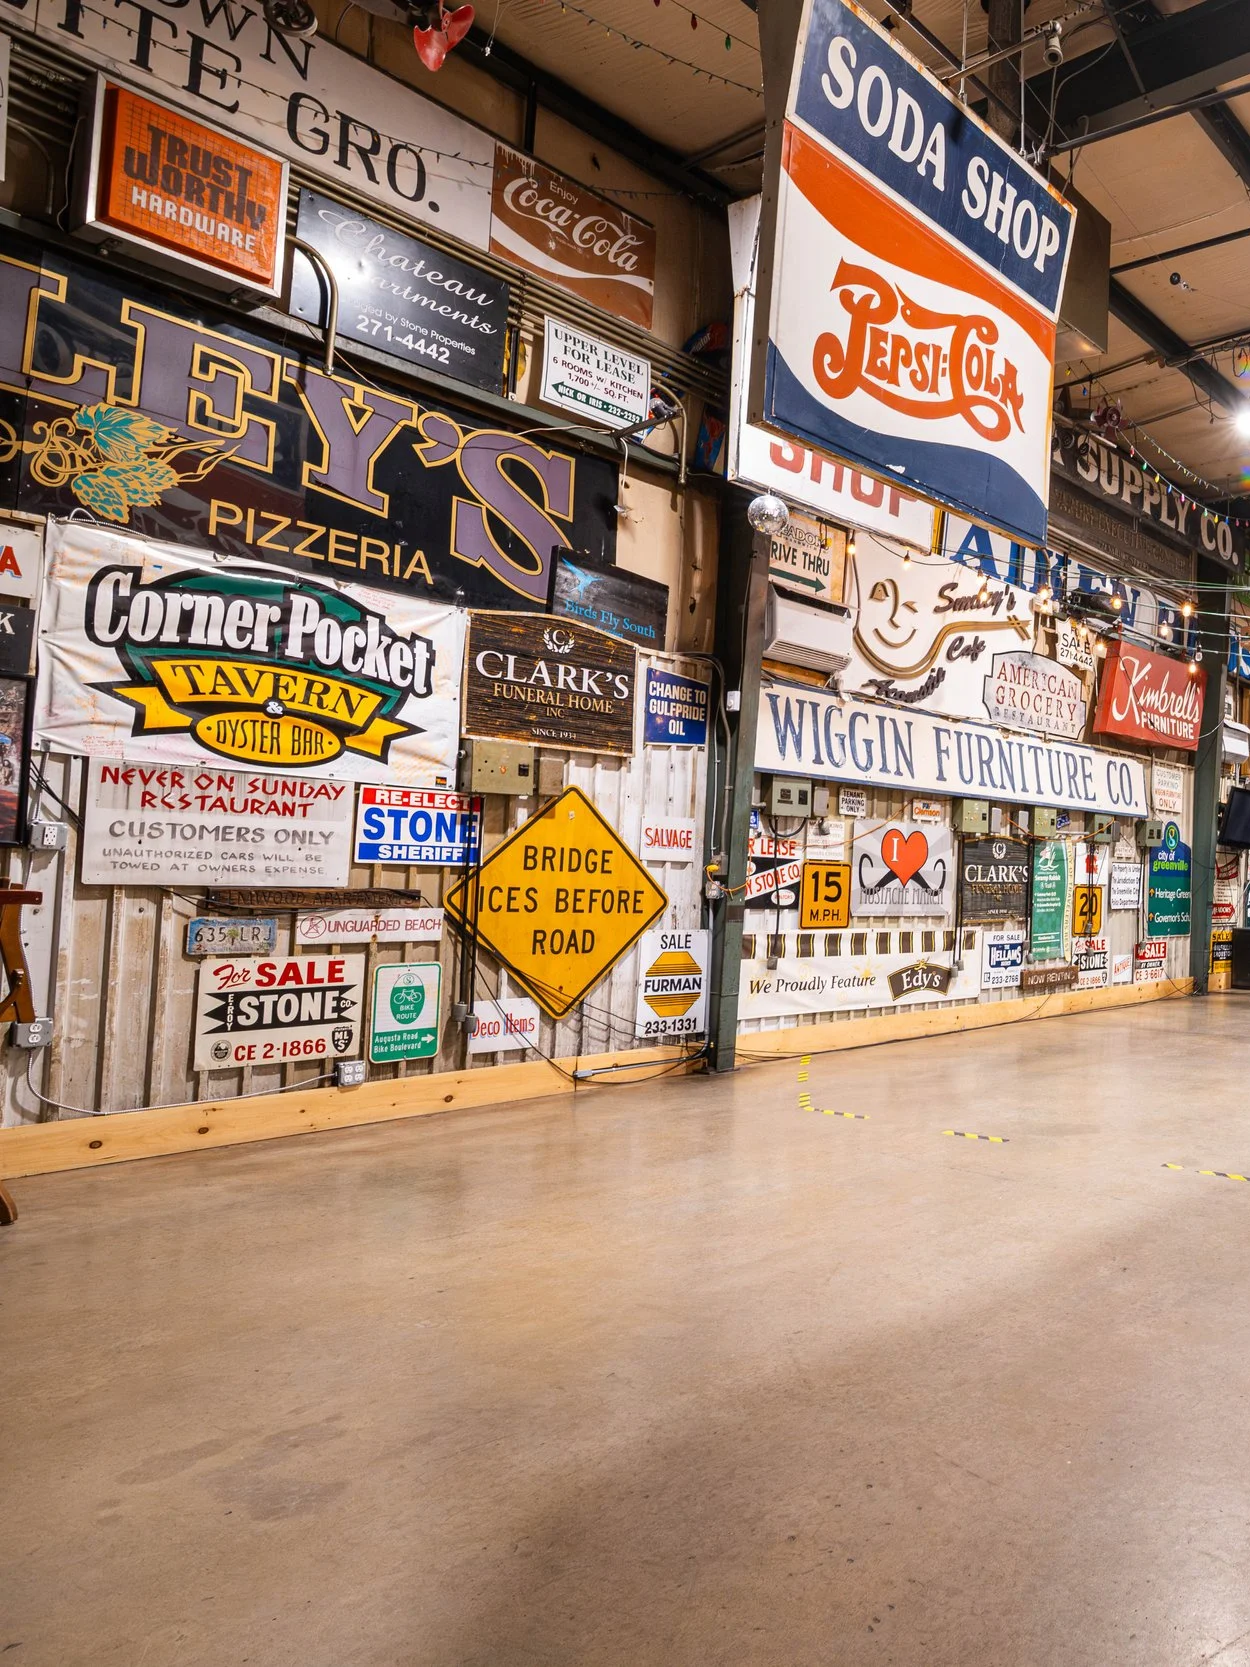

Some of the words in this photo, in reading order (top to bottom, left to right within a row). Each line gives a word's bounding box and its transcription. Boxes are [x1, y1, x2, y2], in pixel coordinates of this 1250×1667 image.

[821, 36, 947, 192] SODA
[147, 124, 252, 196] TRUST
[287, 91, 440, 213] GRO.
[124, 145, 267, 231] WORTHY
[550, 180, 579, 205] Enjoy
[131, 186, 256, 254] HARDWARE
[503, 177, 645, 273] Coca-Cola
[961, 155, 1060, 273] SHOP
[318, 209, 494, 307] Chateau
[356, 314, 451, 365] 271-4442
[385, 311, 399, 324] by
[400, 317, 429, 336] Stone
[430, 330, 476, 356] Properties
[554, 328, 598, 357] UPPER
[603, 346, 645, 377] LEVEL
[563, 345, 591, 366] FOR
[595, 357, 636, 385] LEASE
[552, 355, 559, 365] 6
[561, 359, 593, 382] ROOMS
[609, 379, 645, 401] KITCHEN
[567, 371, 590, 388] 1,700
[558, 384, 575, 400] NICK
[576, 390, 587, 402] OR
[589, 394, 603, 408] IRIS
[1077, 433, 1191, 535] SUPPLY
[1200, 512, 1239, 566] CO.
[208, 498, 435, 586] PIZZERIA
[802, 550, 830, 577] THRU
[565, 599, 598, 620] Birds
[600, 610, 620, 630] Fly
[622, 617, 657, 639] South
[92, 570, 282, 652] Corner
[284, 596, 431, 694] Pocket
[475, 650, 630, 699] CLARK'S
[997, 661, 1078, 700] AMERICAN
[173, 663, 370, 720] TAVERN
[493, 682, 566, 708] FUNERAL
[568, 695, 615, 715] HOME
[649, 680, 693, 703] CHANGE
[694, 688, 707, 705] TO
[995, 685, 1077, 722] GROCERY
[265, 699, 284, 717] &
[546, 707, 565, 719] INC
[649, 698, 706, 722] GULFPRIDE
[994, 707, 1077, 734] RESTAURANT
[215, 718, 282, 756] OYSTER
[291, 724, 325, 757] BAR
[531, 727, 557, 738] SINCE
[668, 718, 686, 736] OIL
[1140, 710, 1195, 740] FURNITURE
[766, 691, 915, 779] WIGGIN
[933, 725, 1097, 802] FURNITURE
[1105, 759, 1139, 809] CO.
[100, 765, 186, 790] NEVER
[194, 772, 235, 793] ON
[247, 779, 346, 802] SUNDAY
[843, 790, 864, 799] TENANT
[140, 790, 314, 818] RESTAURANT
[375, 790, 471, 810] RE-ELECT
[841, 798, 865, 807] PARKING
[846, 805, 860, 813] ONLY
[914, 806, 941, 816] Clemson
[1158, 797, 1177, 809] ONLY
[108, 819, 266, 845] CUSTOMERS
[274, 827, 335, 846] ONLY
[363, 808, 477, 844] STONE
[645, 827, 693, 849] SALVAGE
[102, 847, 214, 861] UNAUTHORIZED
[220, 850, 255, 861] CARS
[262, 852, 293, 863] WILL
[305, 853, 323, 863] BE
[378, 844, 464, 862] SHERIFF
[523, 845, 613, 874] BRIDGE
[761, 838, 797, 857] LEASE
[891, 837, 900, 862] I
[1158, 850, 1168, 862] city
[109, 860, 161, 872] TOWED
[169, 862, 188, 872] AT
[197, 863, 257, 874] OWNERS
[265, 864, 325, 876] EXPENSE
[964, 864, 1028, 883] CLARK'S
[1152, 858, 1189, 872] greenville
[811, 870, 842, 903] 15
[859, 886, 909, 905] MUSTACHE
[912, 886, 944, 905] MARCH
[478, 885, 538, 913] ICES
[555, 888, 645, 914] BEFORE
[1079, 892, 1098, 917] 20
[328, 920, 400, 933] UNGUARDED
[405, 918, 441, 931] BEACH
[809, 909, 842, 921] M.P.H.
[195, 926, 227, 942] 635
[531, 929, 595, 955] ROAD
[660, 934, 692, 950] SALE
[993, 934, 1005, 942] FOR
[1145, 943, 1165, 959] SALE
[212, 963, 252, 991] For
[254, 959, 346, 987] SALE
[643, 977, 702, 993] FURMAN
[749, 979, 772, 994] We
[775, 976, 827, 994] Proudly
[831, 975, 877, 989] Feature
[901, 968, 941, 990] Edy's
[1028, 975, 1045, 985] NOW
[236, 990, 341, 1027] STONE
[340, 1000, 353, 1008] CO.
[396, 1012, 417, 1021] ROUTE
[399, 1004, 414, 1012] BIKE
[503, 1013, 536, 1034] Items
[645, 1018, 697, 1035] 233-1331
[373, 1044, 388, 1053] Bike
[389, 1041, 422, 1053] Boulevard
[374, 1034, 401, 1044] Augusta
[402, 1032, 419, 1041] Road
[234, 1044, 257, 1062] CE
